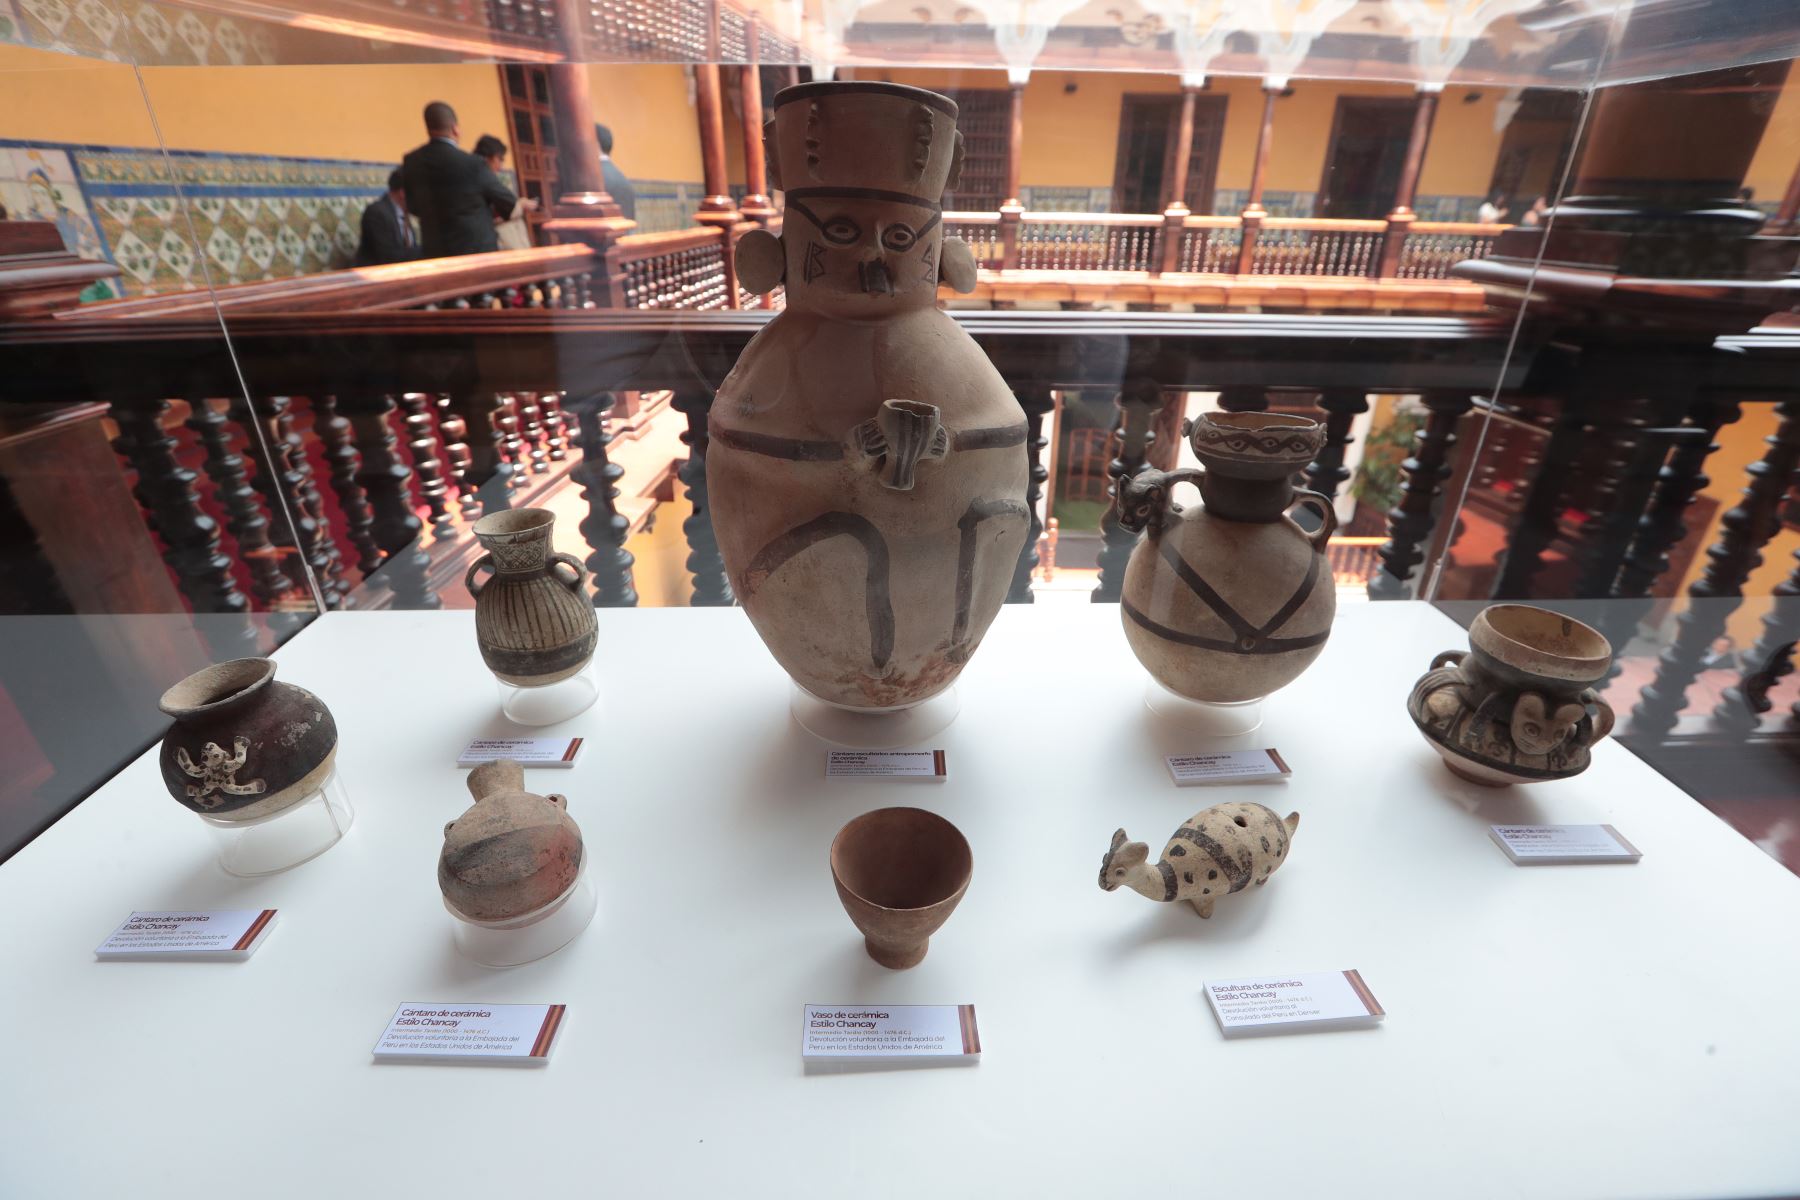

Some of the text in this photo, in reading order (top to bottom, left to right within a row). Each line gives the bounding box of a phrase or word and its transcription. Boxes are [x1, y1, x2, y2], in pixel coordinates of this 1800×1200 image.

[1212, 984, 1252, 992] Escultura
[1216, 992, 1240, 1000] Estilo
[396, 1018, 460, 1028] Estilo Chancay
[836, 1020, 876, 1030] Chancay
